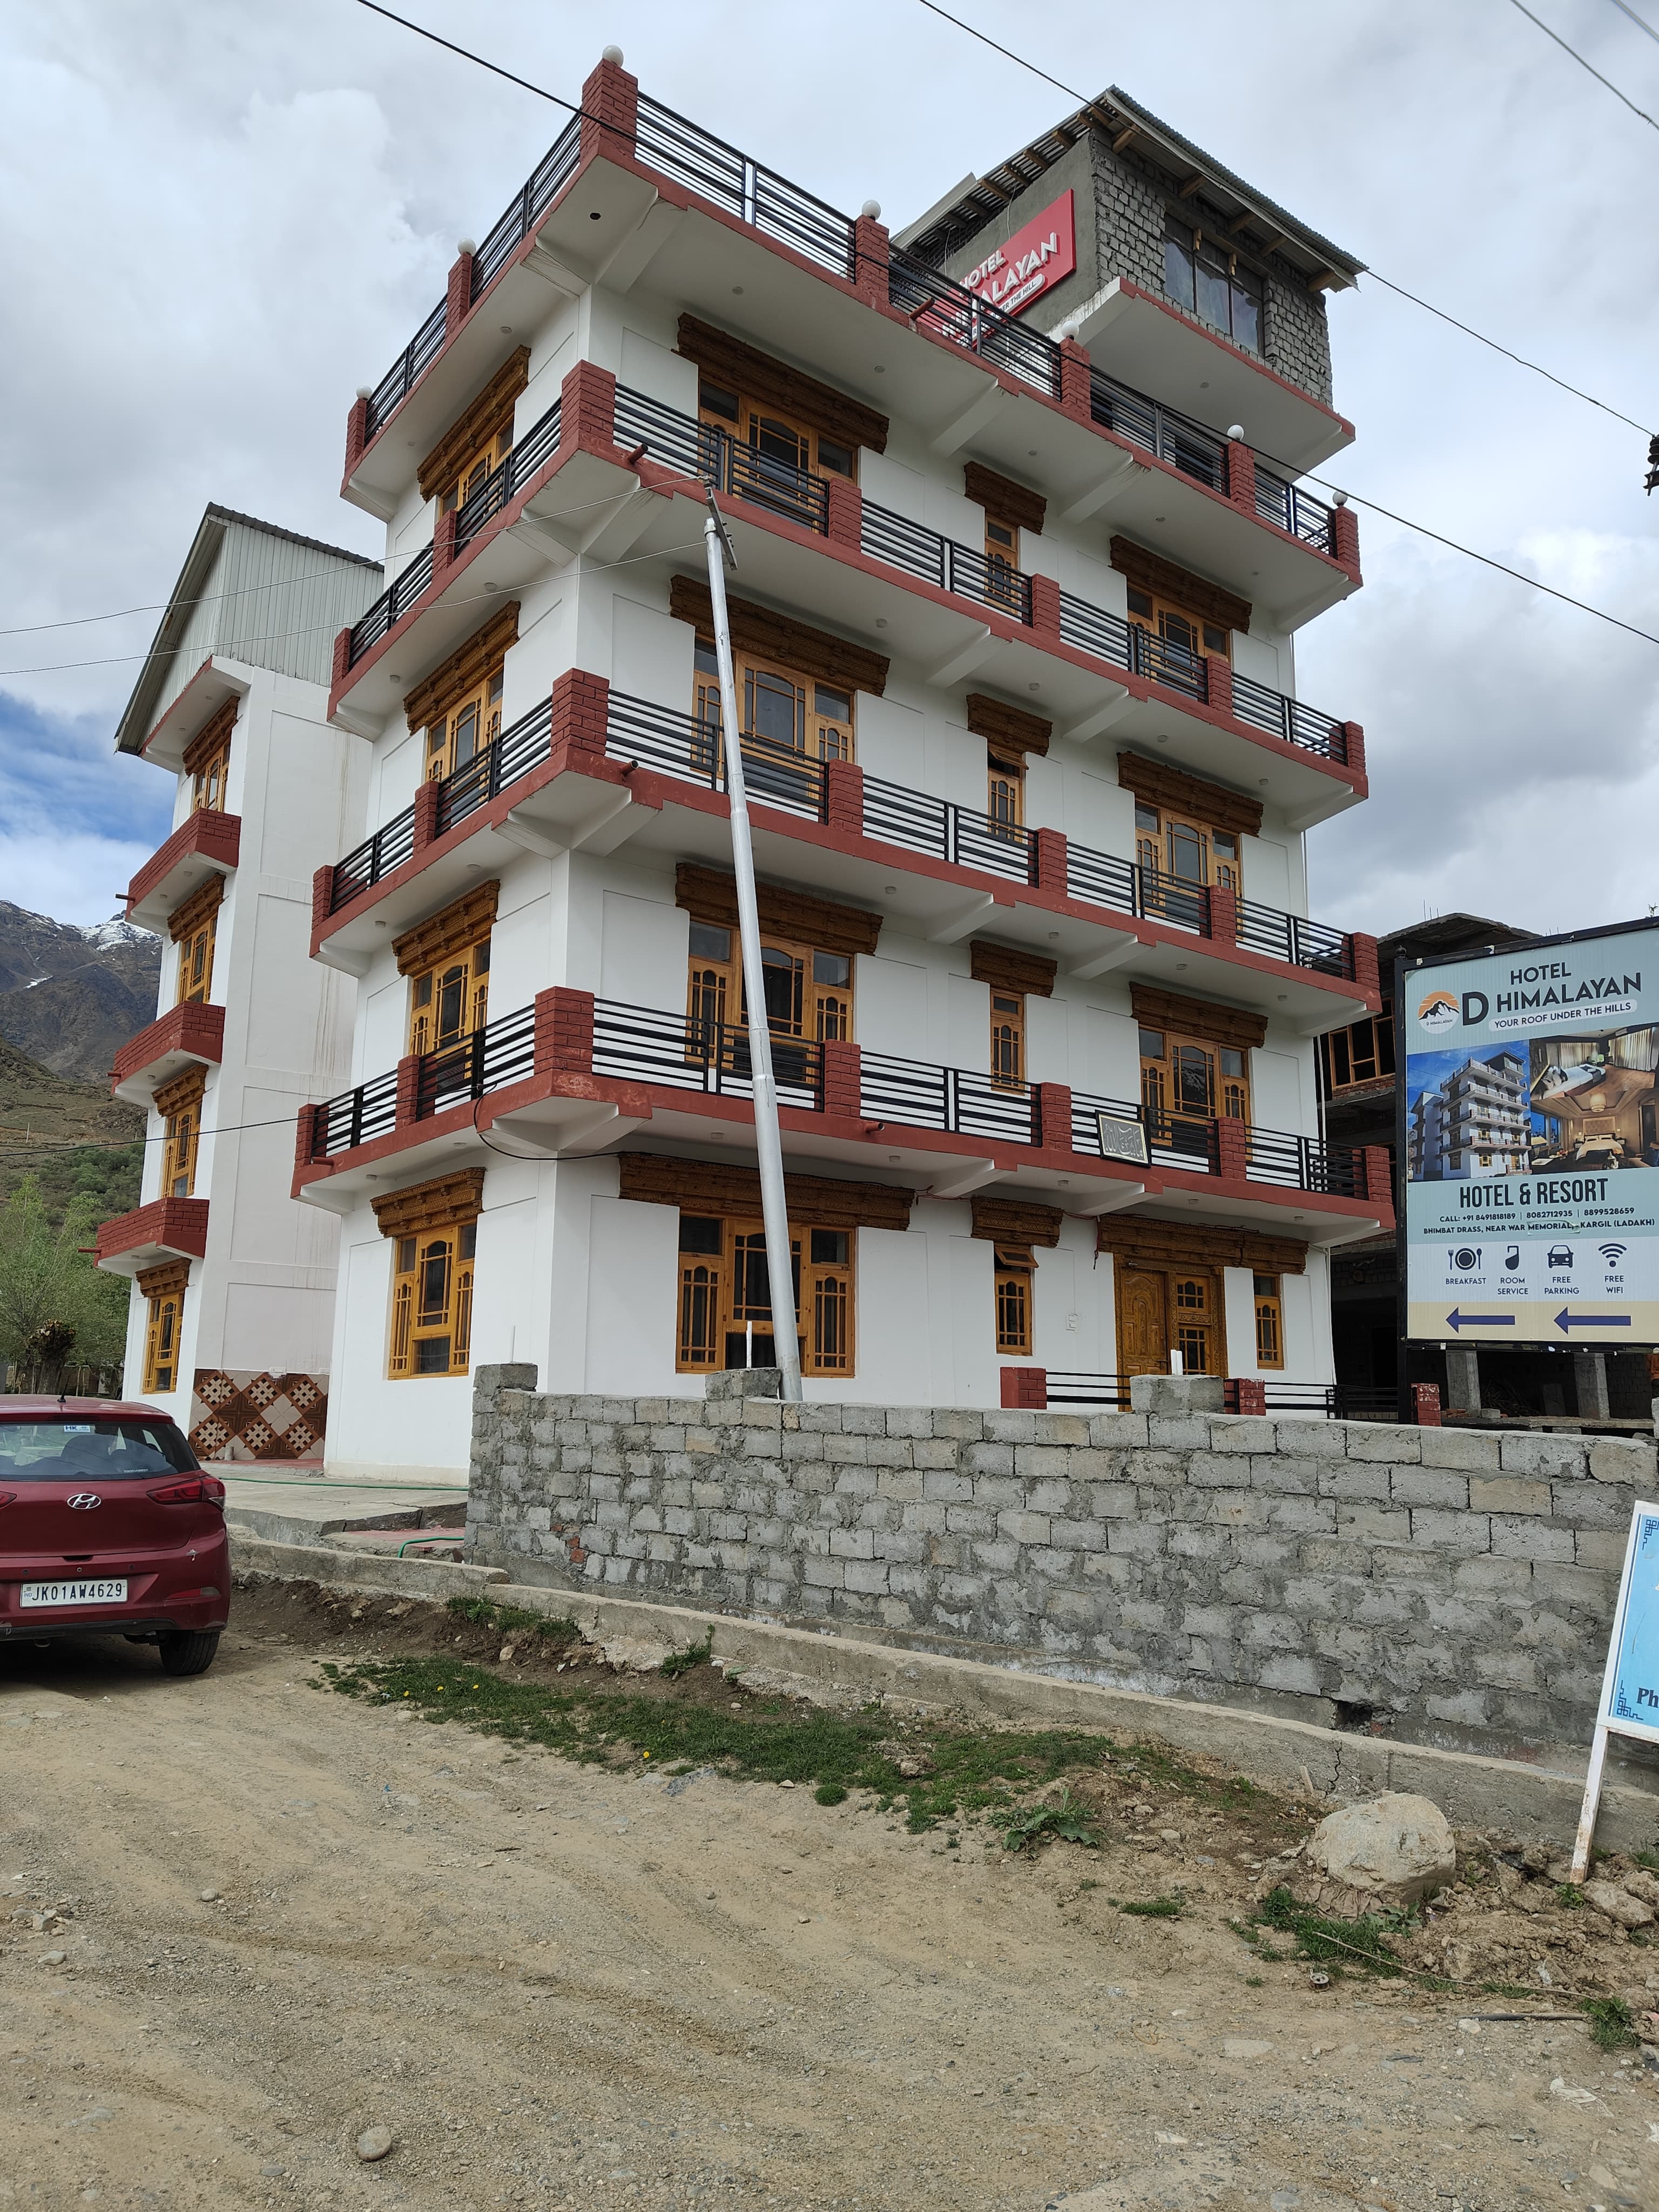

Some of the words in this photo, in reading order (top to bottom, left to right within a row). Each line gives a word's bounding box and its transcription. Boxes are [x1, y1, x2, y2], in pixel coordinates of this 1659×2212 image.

[960, 250, 1005, 289] HOTEL
[1011, 292, 1021, 305] THE
[1510, 962, 1572, 985] HOTEL
[1462, 991, 1489, 1026] D
[1496, 972, 1642, 1013] HIMALAYAN
[1494, 1020, 1519, 1028] YOUR
[1521, 1014, 1548, 1024] ROOF
[1550, 1009, 1581, 1020] UNDER
[1584, 1007, 1602, 1016] THE
[1604, 1002, 1631, 1013] HILLS
[1460, 1184, 1514, 1208] HOTEL
[1520, 1183, 1531, 1205] &
[1537, 1178, 1609, 1204] RESORT
[1526, 1210, 1573, 1219] 8082712935
[1584, 1207, 1635, 1216] 8899528659
[1580, 1220, 1612, 1229] KARGIL
[1614, 1218, 1655, 1228] (LADAKH)
[32, 1583, 122, 1601] JK01AW4629
